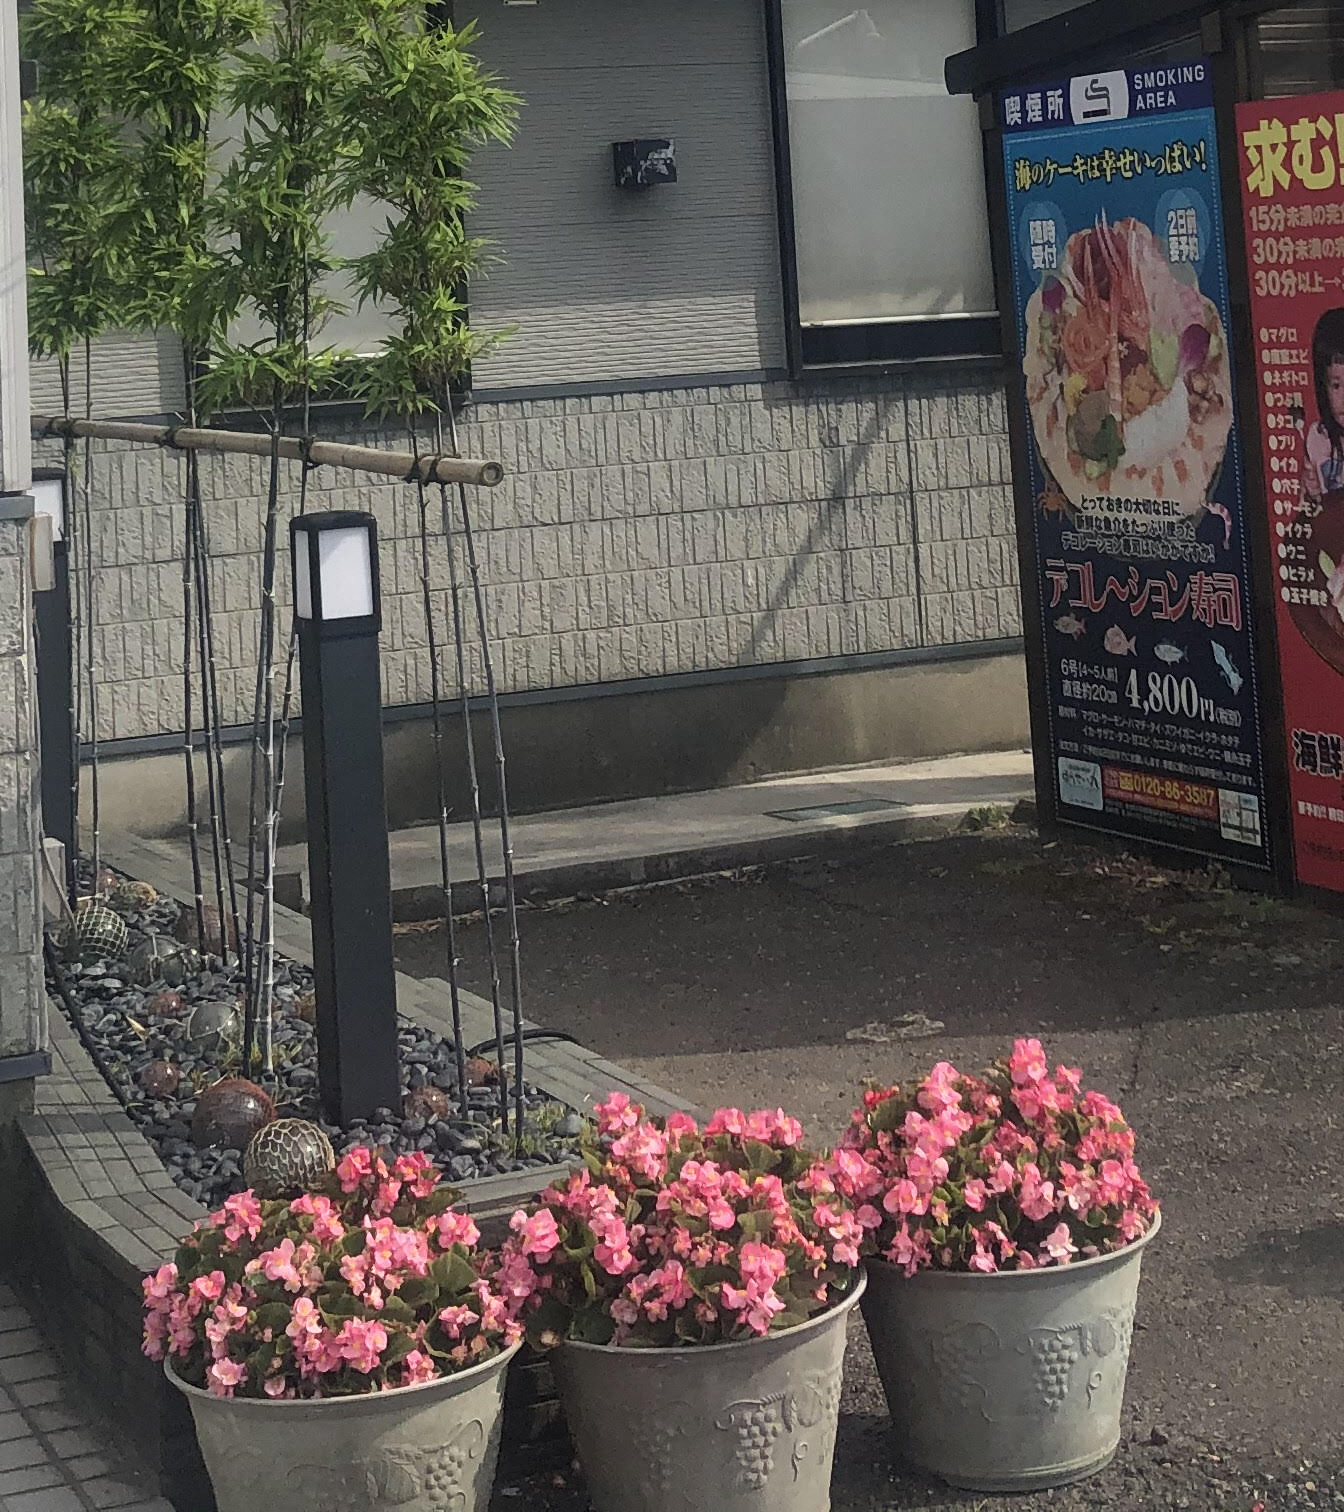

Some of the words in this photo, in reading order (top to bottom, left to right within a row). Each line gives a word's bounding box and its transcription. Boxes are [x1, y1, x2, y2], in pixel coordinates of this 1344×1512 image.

[1133, 64, 1206, 91] SMOKING
[1004, 88, 1064, 127] 喫煙所
[1135, 90, 1178, 112] AREA
[1268, 327, 1298, 344] マグロ
[1271, 369, 1310, 387] ネギトロ
[1276, 413, 1295, 430] タコ
[1279, 456, 1299, 474] イカ
[1286, 544, 1307, 560] ウニ
